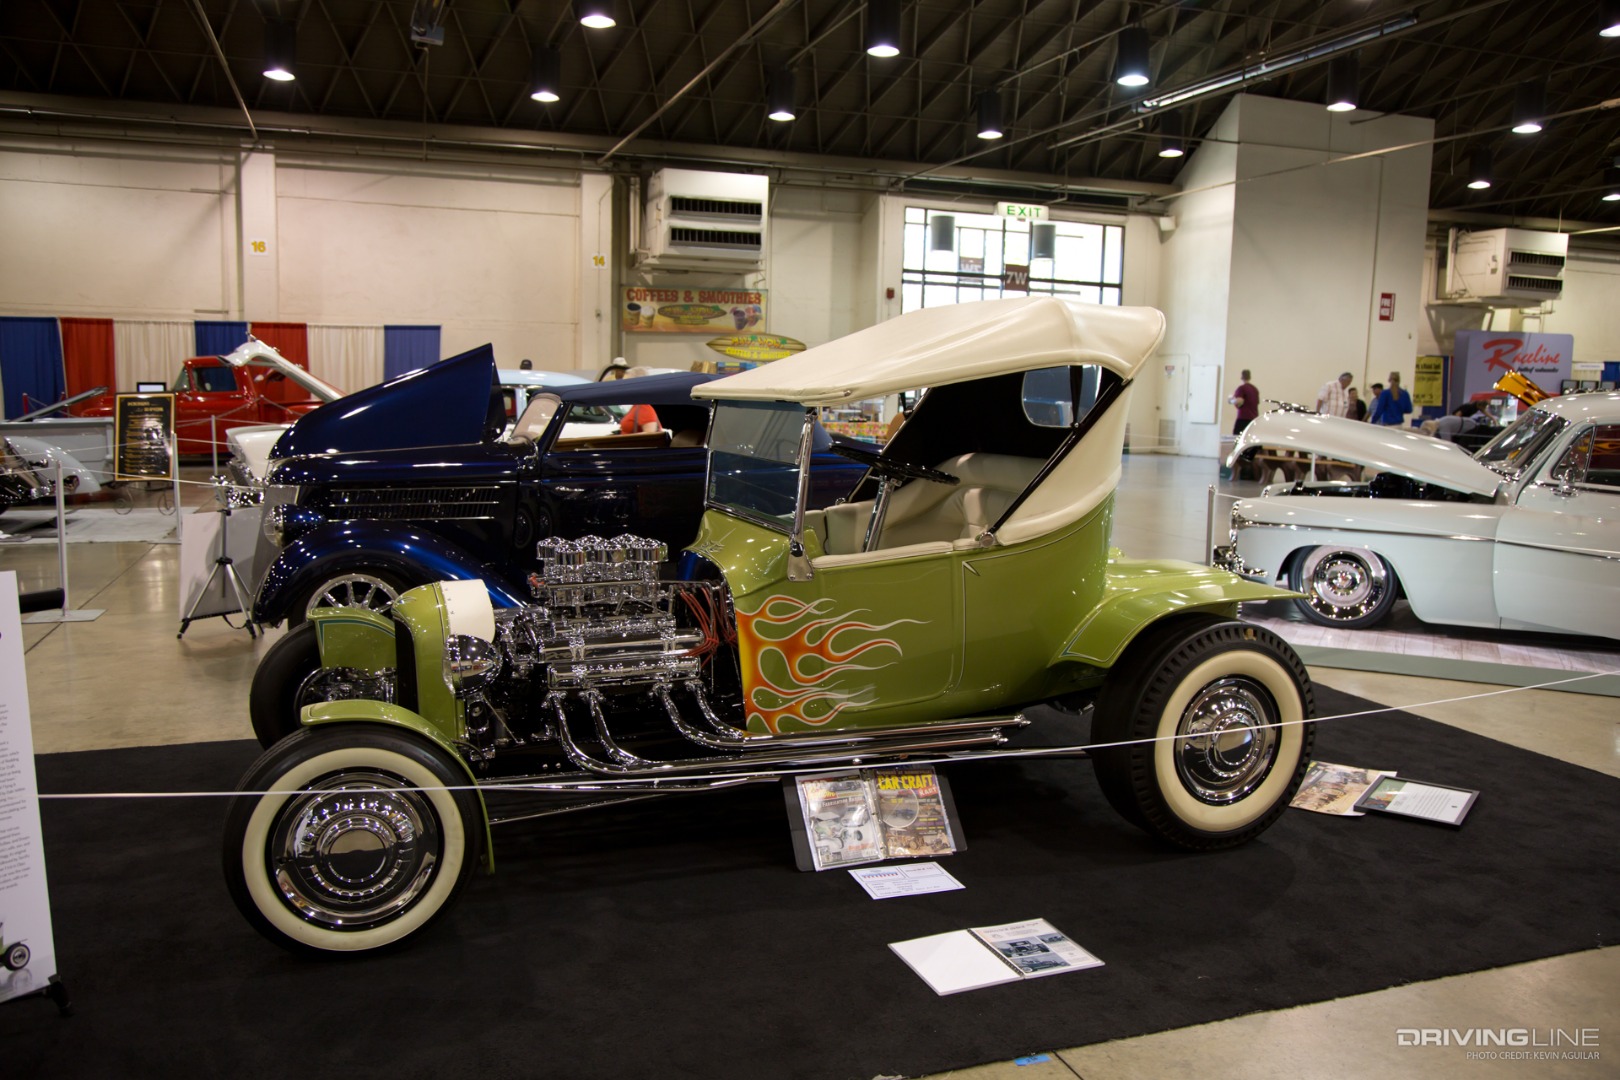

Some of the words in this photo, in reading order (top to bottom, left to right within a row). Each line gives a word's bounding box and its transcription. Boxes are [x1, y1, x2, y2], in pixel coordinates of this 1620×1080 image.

[1006, 205, 1042, 218] EXIT
[251, 240, 266, 253] 16
[592, 255, 605, 266] 14
[1006, 271, 1027, 285] 7W
[626, 288, 678, 302] COFFEES
[683, 290, 695, 303] &
[698, 290, 762, 305] SMOOTHIES
[1483, 338, 1561, 372] Raceline
[878, 775, 900, 790] CAR
[901, 774, 933, 790] CRAFT
